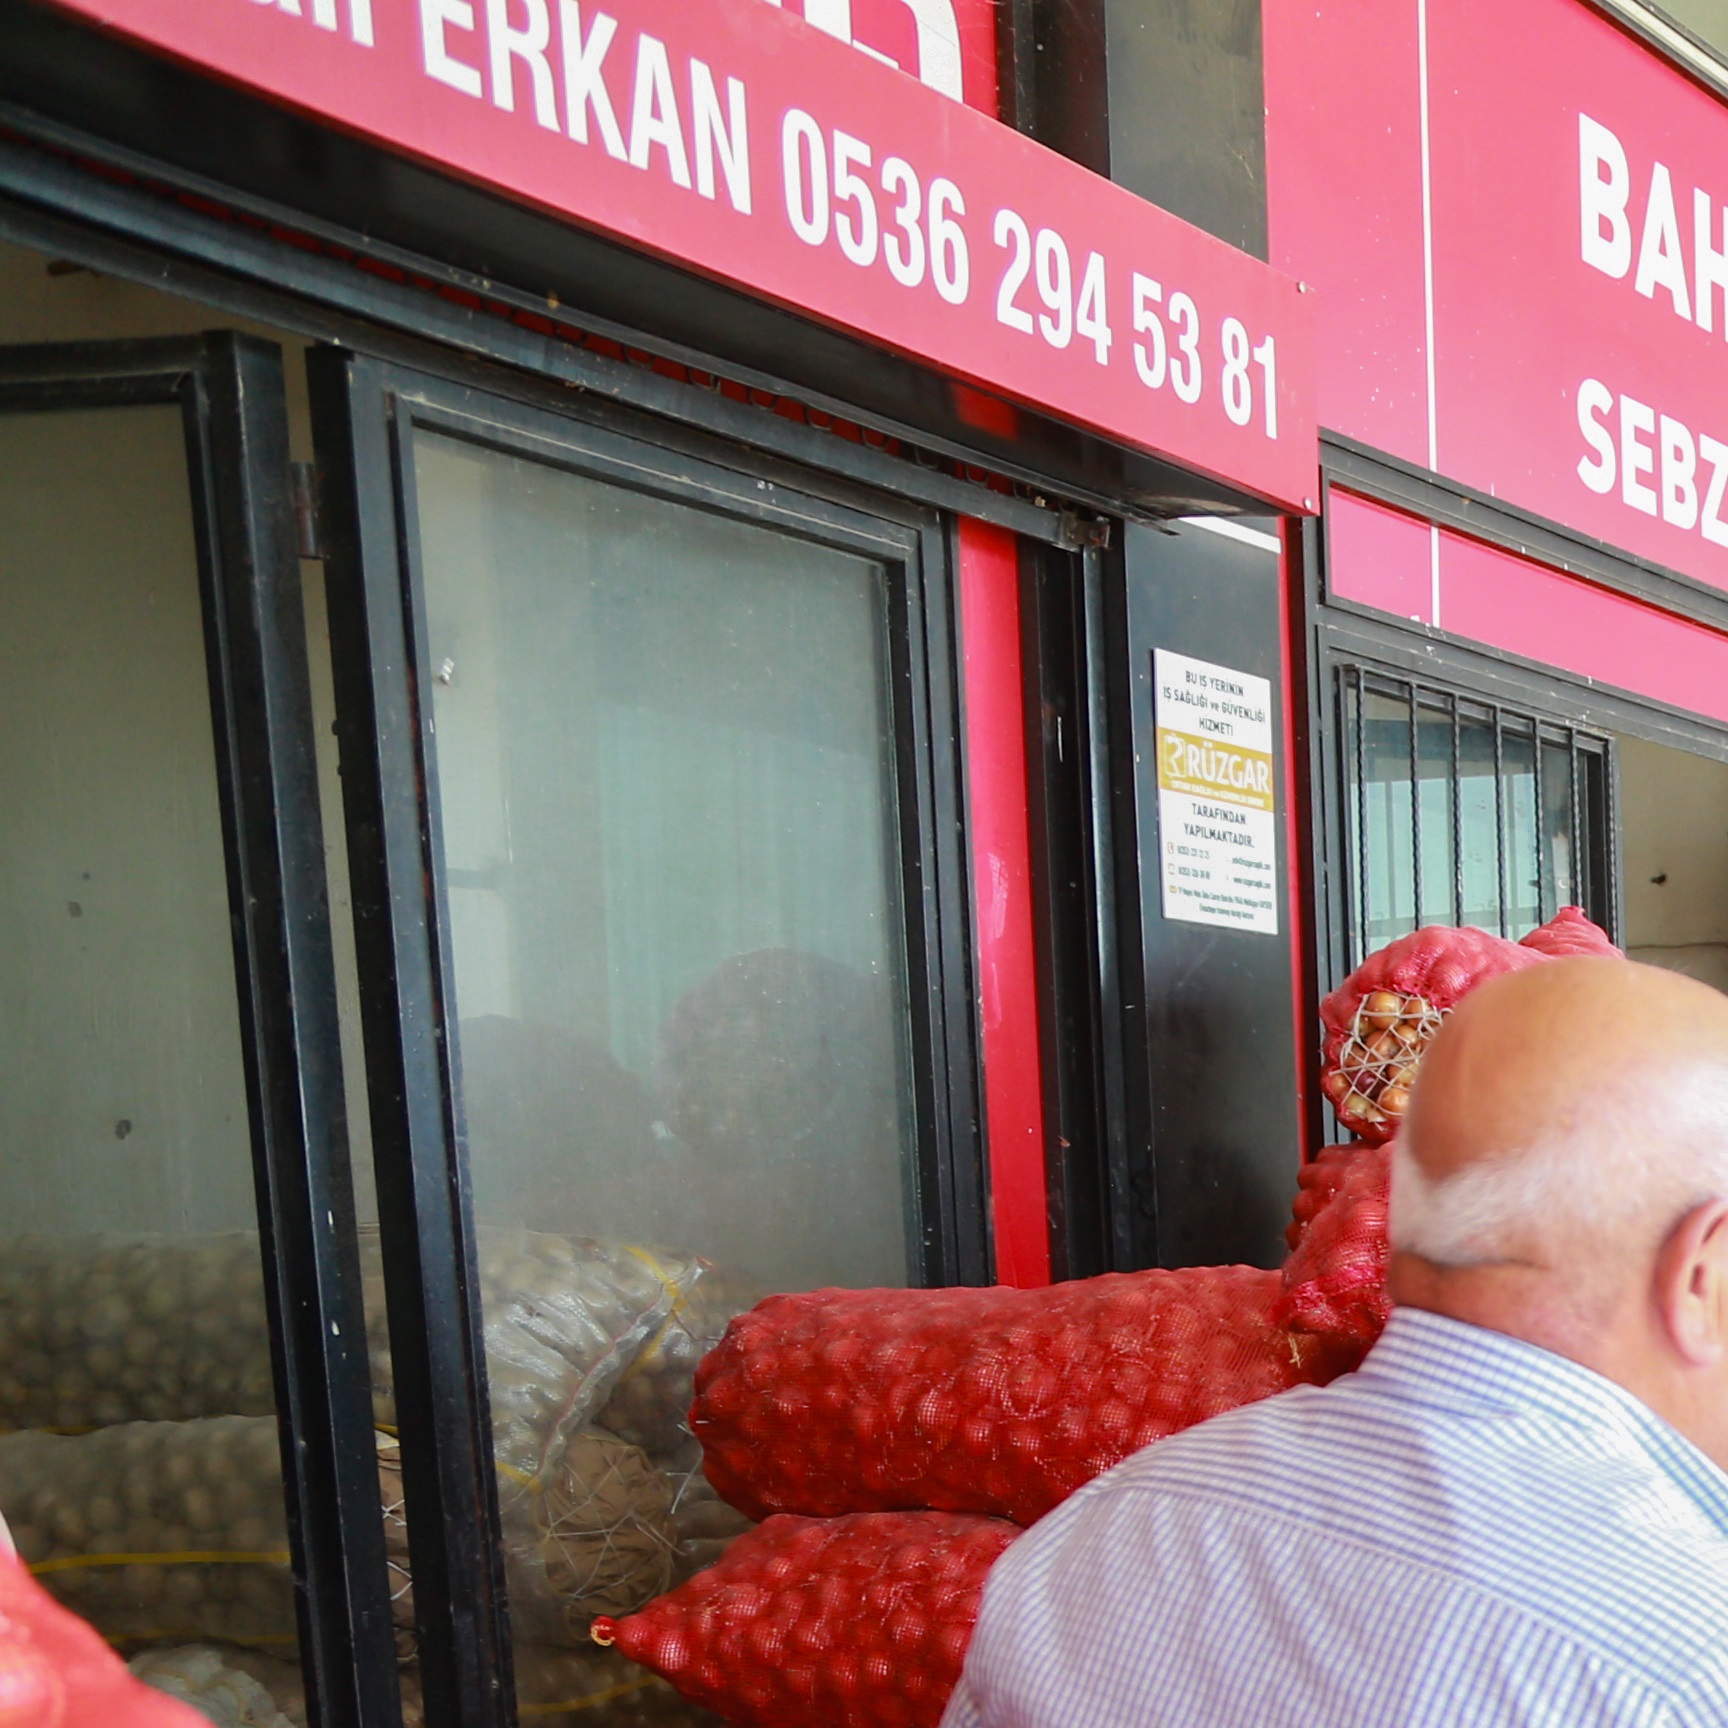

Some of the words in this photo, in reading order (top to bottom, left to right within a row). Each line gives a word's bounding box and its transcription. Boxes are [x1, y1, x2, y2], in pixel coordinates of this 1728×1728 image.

[419, 0, 752, 215] ERKAN
[782, 108, 970, 305] 0536
[994, 208, 1112, 366] 294
[1133, 271, 1202, 403] 53
[1221, 317, 1278, 440] 81
[1185, 670, 1198, 685] BU
[1187, 741, 1271, 796] RÜZGAR
[1192, 802, 1246, 826] TARAFINDAN
